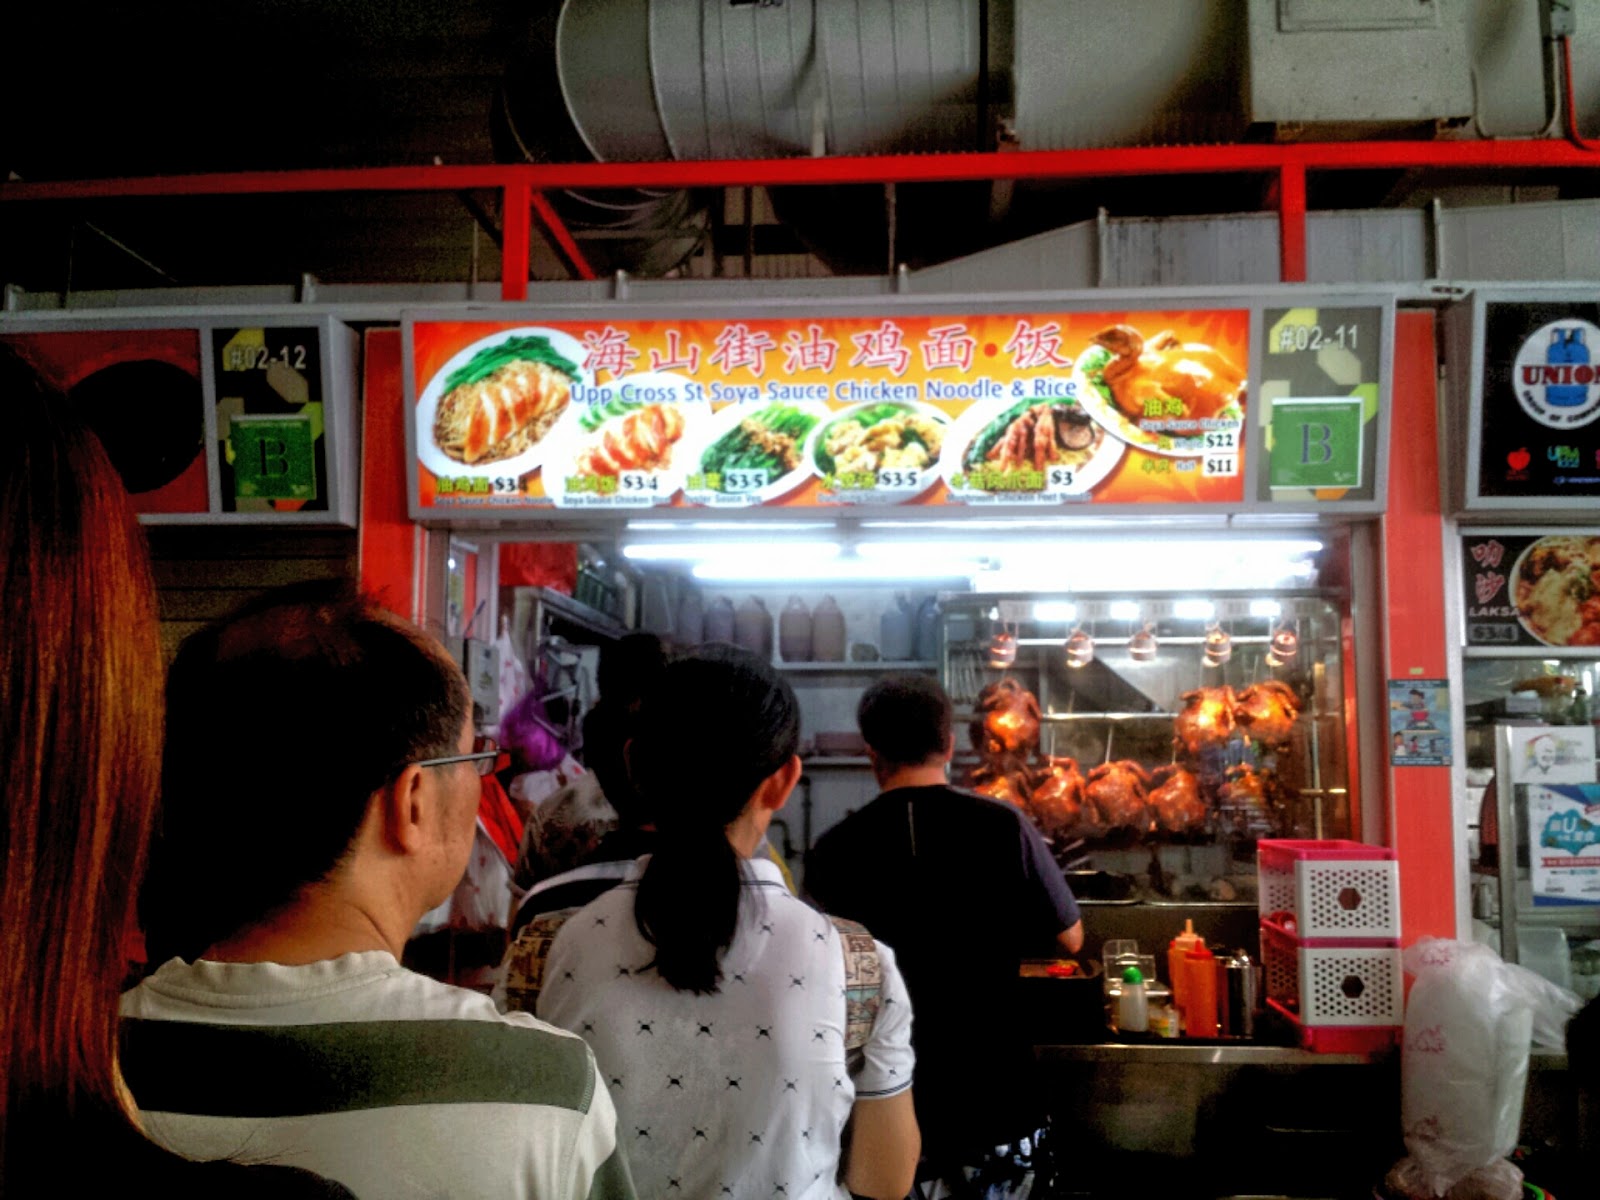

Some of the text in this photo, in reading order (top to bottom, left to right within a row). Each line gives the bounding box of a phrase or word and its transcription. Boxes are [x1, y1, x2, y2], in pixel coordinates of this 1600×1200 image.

[1280, 325, 1358, 350] #02-11
[231, 345, 307, 369] #02-12
[571, 379, 1077, 406] Upp Cross St Soya Sauce Chicken Noodle & Rice
[1206, 434, 1234, 448] $22
[1298, 422, 1333, 465] B
[255, 437, 290, 479] B
[1207, 459, 1232, 474] $11
[1051, 470, 1073, 486] $3
[1469, 607, 1520, 616] LAKSA
